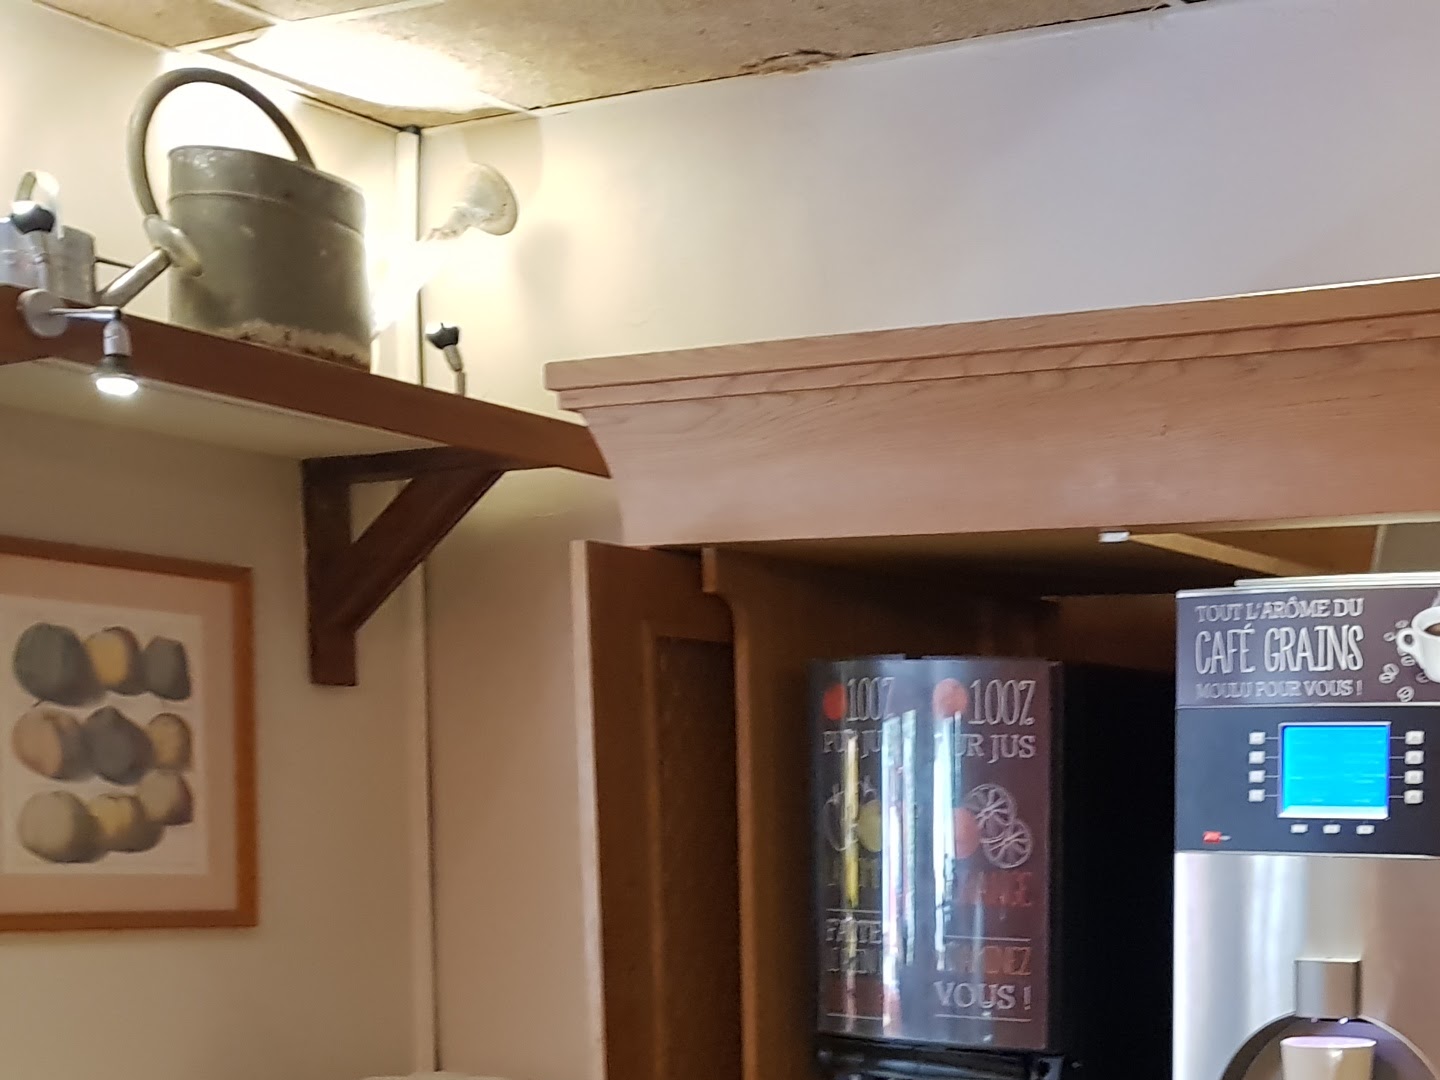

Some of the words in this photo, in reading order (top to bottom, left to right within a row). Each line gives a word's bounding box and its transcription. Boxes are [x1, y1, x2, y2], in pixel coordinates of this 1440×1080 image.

[1196, 603, 1243, 622] TOUT
[1245, 595, 1329, 620] L'ARÔME
[1333, 597, 1364, 616] DU
[1195, 623, 1256, 674] CAFÉ
[1264, 624, 1364, 672] GRAINS
[968, 678, 1037, 726] 100%
[1195, 682, 1252, 700] MOULU
[1254, 681, 1302, 698] POUR
[1304, 680, 1353, 697] VOUS
[987, 732, 1037, 764] JUS
[934, 981, 1016, 1010] VOUS
